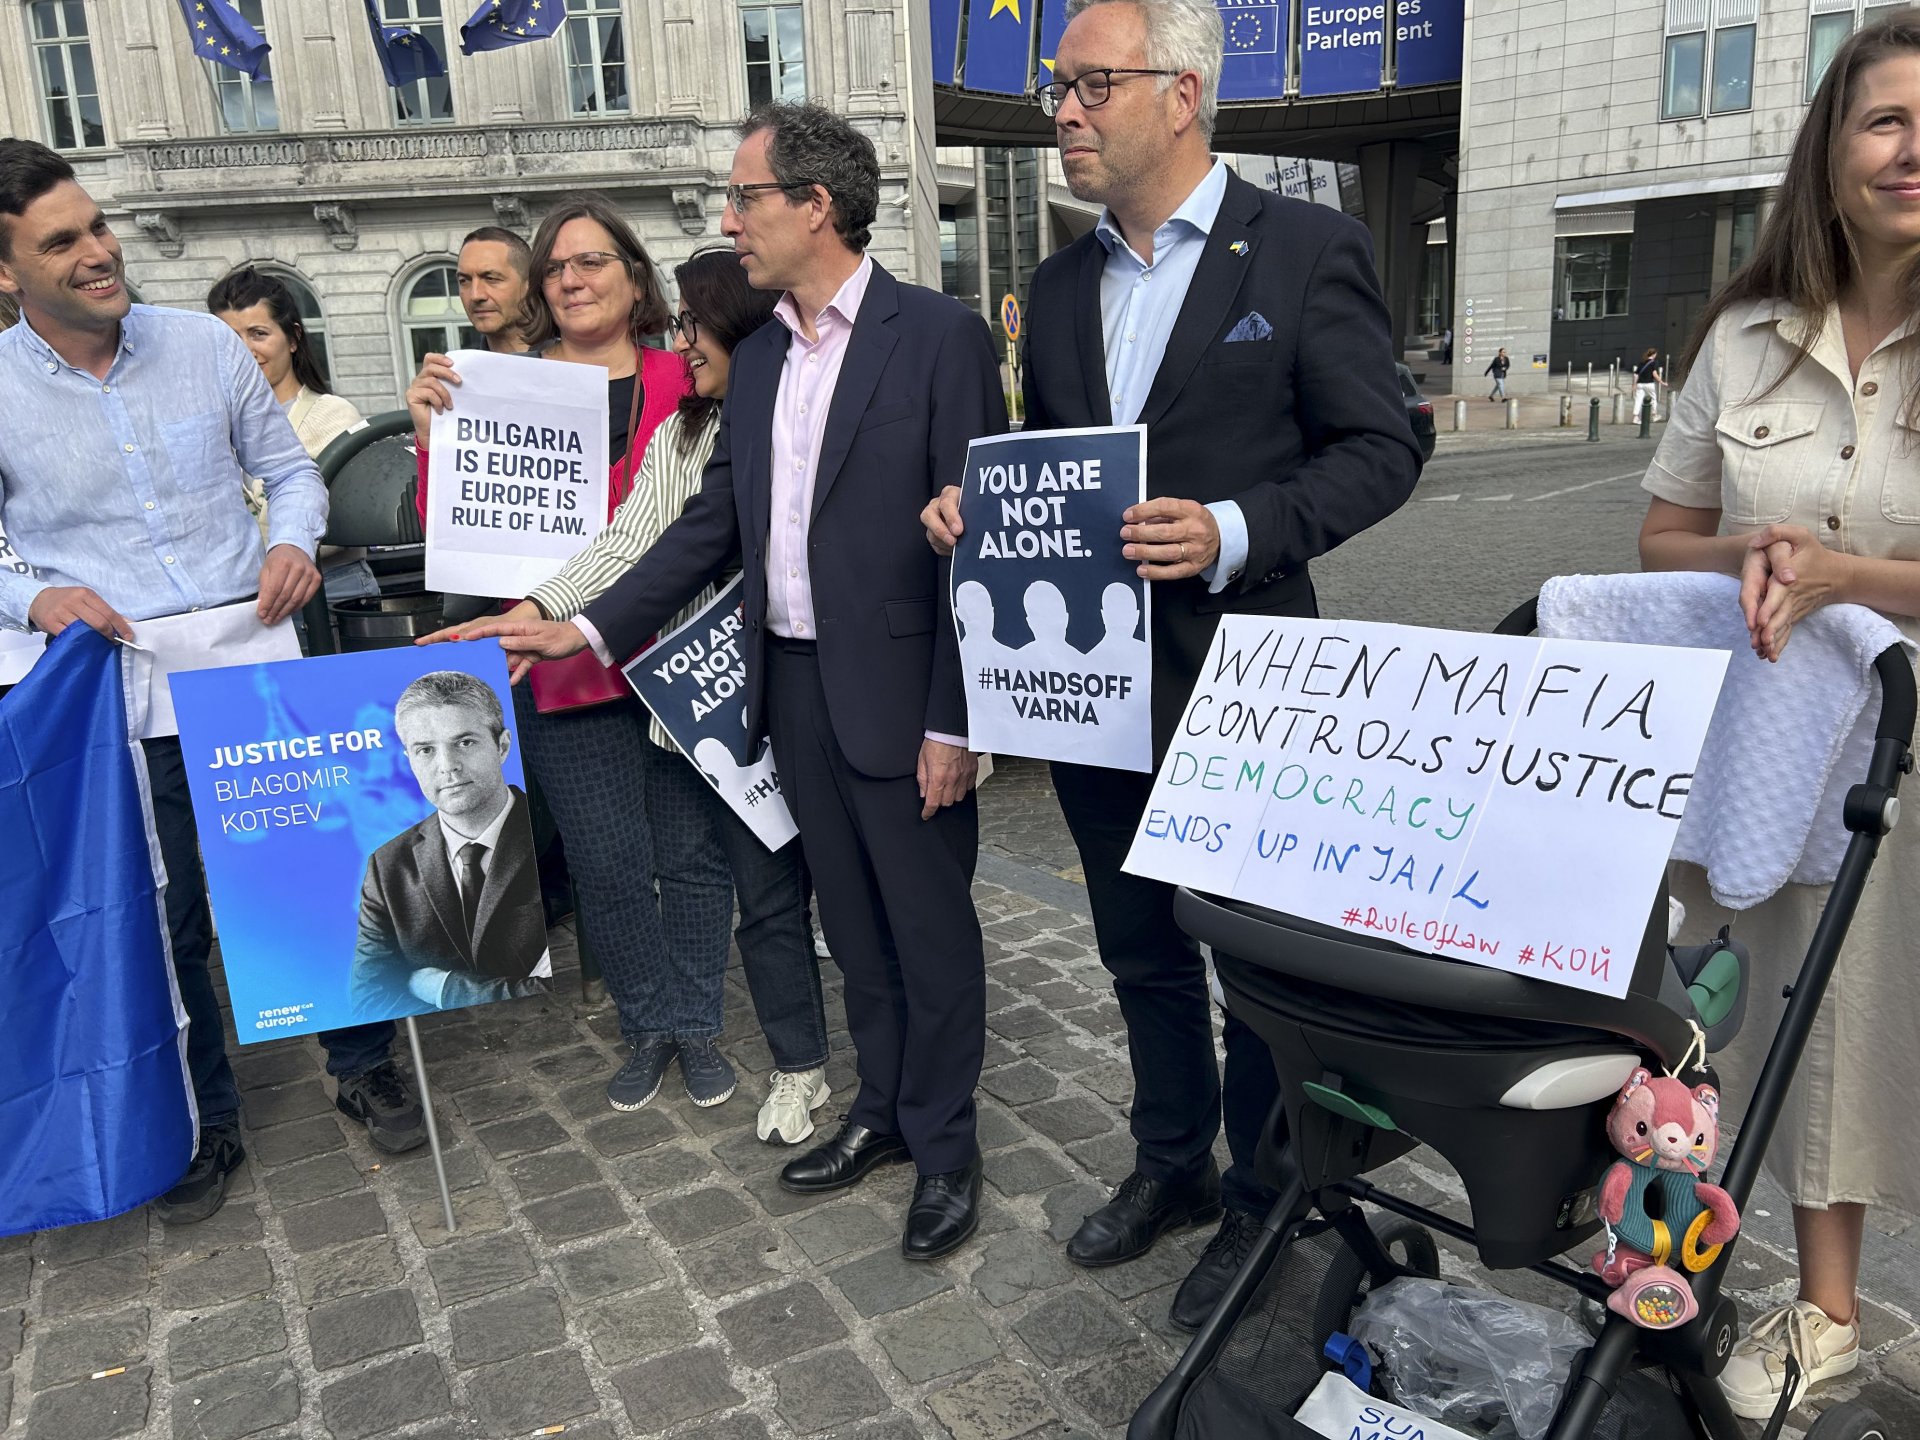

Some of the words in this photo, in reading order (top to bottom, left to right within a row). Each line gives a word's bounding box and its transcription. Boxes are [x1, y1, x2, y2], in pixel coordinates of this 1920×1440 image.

[1307, 20, 1433, 51] Parlement
[457, 417, 583, 454] BULGARIA
[455, 449, 479, 473] IS
[487, 452, 589, 485] EUROPE.
[978, 463, 1028, 495] YOU
[1036, 459, 1102, 492] ARE
[461, 480, 550, 508] EUROPE
[556, 489, 577, 511] IS
[1001, 496, 1066, 527] NOT
[451, 507, 503, 529] RULE
[508, 512, 534, 531] OF
[540, 514, 587, 537] LAW.
[978, 529, 1093, 559] ALONE.
[652, 639, 705, 685] YOU
[690, 638, 742, 688] NOT
[691, 661, 747, 722] ALON
[978, 667, 1133, 700] #HANDSOFF
[1213, 628, 1401, 699] WHEN
[1411, 652, 1656, 739] MAFIA
[1011, 695, 1100, 726] VARNA
[208, 736, 324, 769] JUSTICE
[329, 729, 383, 754] FOR
[1186, 694, 1452, 774] CONTROLS
[1467, 738, 1694, 820] JUSTICE
[215, 765, 350, 802] BLAGOMIR
[1167, 751, 1475, 841] DEMOCRACY
[221, 801, 322, 834] KOTSEV
[1145, 809, 1231, 853] ENDS
[1257, 829, 1298, 863] UP
[1313, 841, 1360, 874] IN
[1369, 845, 1490, 910] JAIL
[256, 1014, 308, 1029] europe.
[259, 1005, 301, 1019] renew
